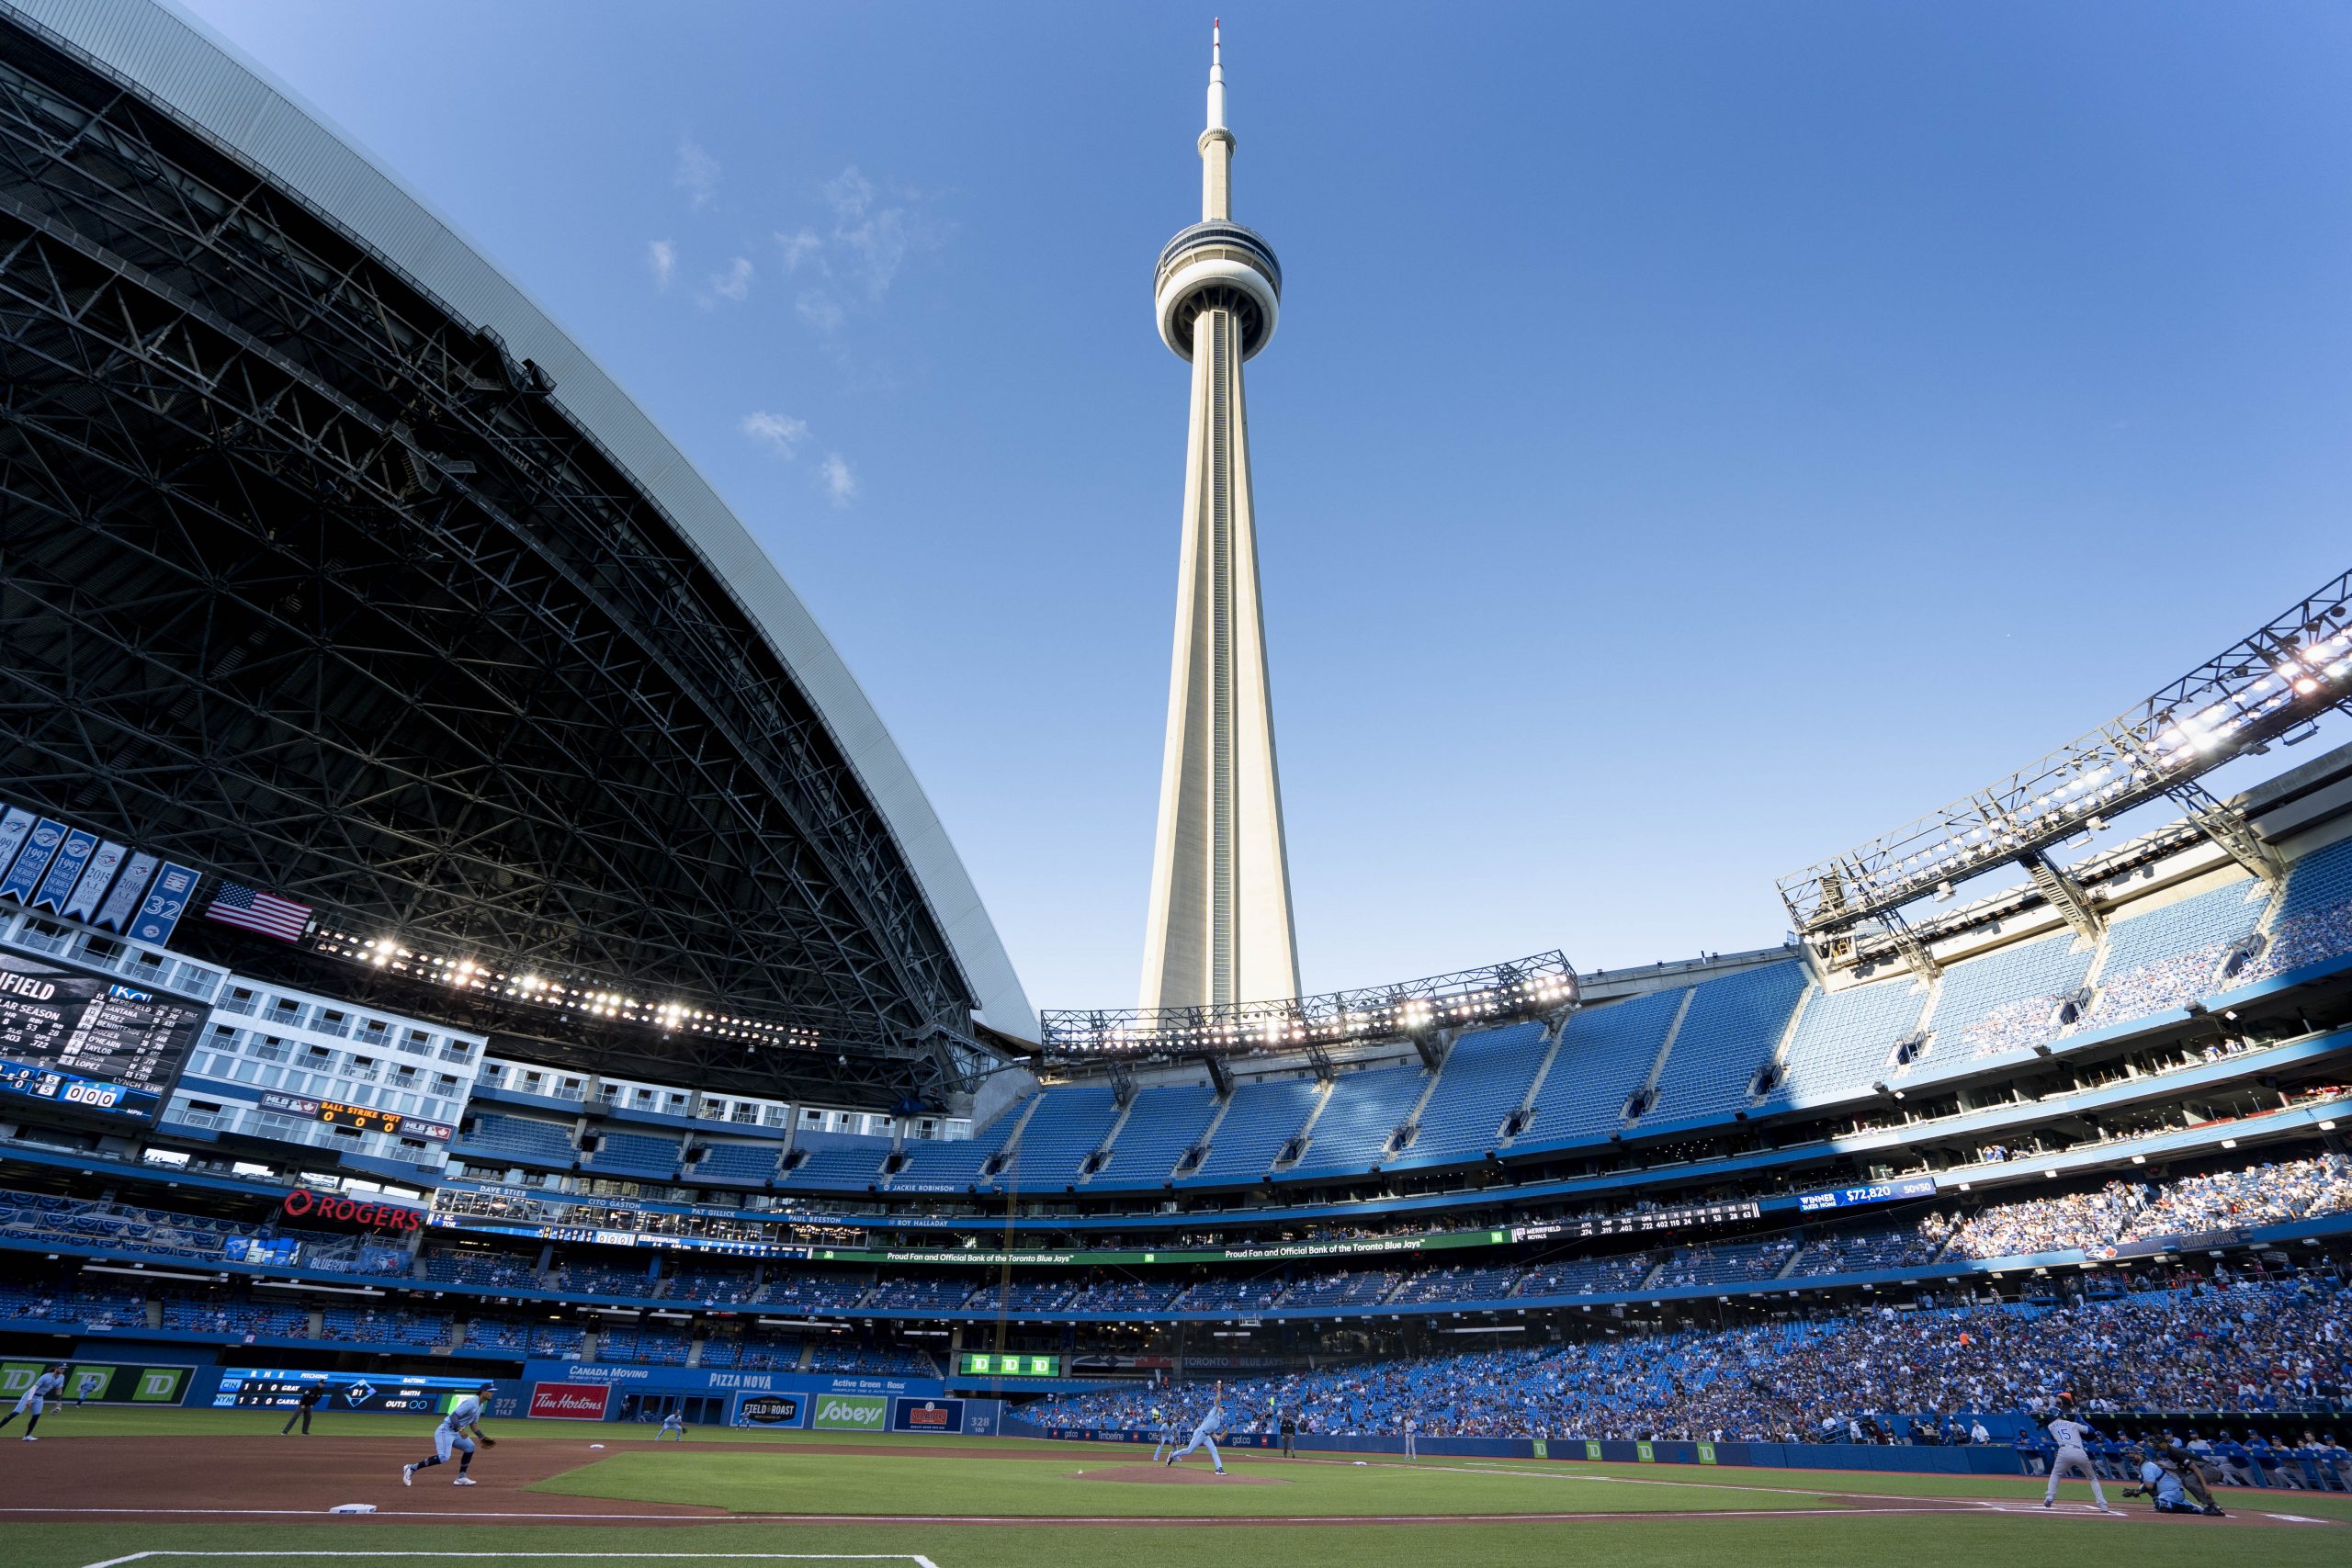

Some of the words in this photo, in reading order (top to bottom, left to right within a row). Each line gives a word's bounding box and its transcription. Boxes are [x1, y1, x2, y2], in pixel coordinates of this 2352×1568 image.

[0, 837, 17, 852] 991
[24, 847, 49, 863] 1992
[20, 858, 42, 871] WORLD
[58, 857, 81, 874] 1993
[15, 866, 37, 878] SERIES
[53, 869, 74, 881] WORLD
[86, 868, 111, 883] 2015
[10, 874, 33, 887] CHAMPS
[49, 876, 70, 888] SERIES
[119, 878, 141, 893] 2016
[44, 885, 66, 897] CHAMPS
[144, 895, 182, 920] 32
[96, 992, 106, 1000] 15
[109, 996, 152, 1013] MERRIFIELD
[19, 1004, 61, 1021] SEASON
[100, 1011, 126, 1023] PEREZ
[104, 1004, 138, 1019] SANTANA
[26, 1023, 39, 1032] 53
[28, 1017, 44, 1025] RBI
[96, 1019, 141, 1036] BENINTENDI
[7, 1027, 23, 1035] SLG
[34, 1033, 51, 1042] OPS
[48, 1029, 61, 1037] 28
[92, 1027, 120, 1040] DOZIER
[29, 1039, 50, 1049] .722
[88, 1034, 122, 1049] O'HEARN
[84, 1043, 113, 1055] TAYLOR
[80, 1050, 107, 1063] DYSON
[74, 1058, 101, 1071] LOPEZ
[20, 1069, 29, 1078] 0
[15, 1079, 24, 1089] 0
[112, 1076, 141, 1089] LYNCH
[144, 1084, 164, 1094] LHP
[71, 1088, 81, 1099] 0
[86, 1091, 96, 1101] 0
[102, 1094, 112, 1105] 0
[265, 1094, 288, 1106] MLB
[127, 1108, 143, 1116] MPH
[321, 1101, 345, 1112] BALL
[347, 1106, 379, 1119] STRIKE
[382, 1112, 401, 1123] OUT
[323, 1111, 334, 1122] 0
[355, 1116, 366, 1128] 0
[384, 1122, 394, 1133] 0
[404, 1121, 425, 1134] MLB
[480, 1185, 501, 1194] DAVE
[504, 1187, 526, 1198] STIEB
[918, 1184, 955, 1192] ROBINSON
[1846, 1185, 1892, 1202] $72,820
[588, 1197, 606, 1207] CITO
[609, 1200, 641, 1210] GASTON
[1800, 1193, 1836, 1205] WINNER
[1802, 1202, 1819, 1211] TAKES
[1819, 1200, 1838, 1209] HOME
[316, 1196, 423, 1232] ROGERS
[707, 1209, 735, 1218] GILLICK
[788, 1214, 808, 1223] PAUL
[808, 1215, 842, 1224] BEESTON
[442, 1220, 457, 1228] TOR
[1600, 1226, 1612, 1235] .319
[1619, 1224, 1633, 1233] .403
[1641, 1223, 1654, 1231] .722
[1683, 1217, 1692, 1225] 24
[1729, 1213, 1738, 1221] 28
[1742, 1211, 1752, 1219] 63
[1526, 1225, 1561, 1235] MERRIFIELD
[2179, 1231, 2240, 1249] CHAMPIONS
[1226, 1250, 1248, 1258] Proud
[1249, 1249, 1263, 1258] Fan
[1264, 1247, 1279, 1257] and
[1280, 1246, 1308, 1257] Official
[1309, 1245, 1328, 1255] Bank
[1329, 1244, 1339, 1253] of
[1339, 1244, 1351, 1253] the
[1353, 1241, 1384, 1252] Toronto
[1385, 1240, 1402, 1250] Blue
[888, 1252, 910, 1260] Proud
[924, 1253, 938, 1261] and
[939, 1253, 967, 1262] Official
[967, 1254, 986, 1262] Bank
[986, 1254, 994, 1262] of
[994, 1254, 1007, 1262] the
[1008, 1255, 1035, 1263] Toronto
[1036, 1254, 1053, 1262] Blue
[974, 1358, 988, 1370] TD
[1003, 1359, 1018, 1371] TD
[1033, 1359, 1047, 1371] TD
[1184, 1356, 1229, 1367] TORONTO
[1239, 1356, 1261, 1367] BLUE
[1262, 1357, 1284, 1367] JAYS
[250, 1370, 257, 1378] R
[570, 1365, 607, 1377] CANADA
[610, 1367, 649, 1379] MOVING
[3, 1369, 36, 1390] TD
[145, 1374, 175, 1394] TD
[708, 1372, 741, 1387] PIZZA
[742, 1374, 772, 1390] NOVA
[832, 1379, 857, 1388] Active
[859, 1380, 881, 1388] Green
[887, 1381, 906, 1389] Ross
[400, 1389, 421, 1397] SMITH
[385, 1400, 407, 1408] OUTS
[494, 1398, 516, 1408] 375
[536, 1393, 557, 1408] Tim
[557, 1393, 602, 1411] Hortons
[744, 1404, 767, 1415] FIELD
[771, 1404, 795, 1416] ROAST
[818, 1400, 883, 1425] Sobeys
[970, 1416, 990, 1427] 328
[1098, 1430, 1125, 1441] Timberline
[2057, 1428, 2072, 1440] 15
[1534, 1443, 1546, 1456] TD
[1587, 1444, 1600, 1458] TD
[1638, 1445, 1653, 1459] TD
[1700, 1446, 1714, 1461] TD
